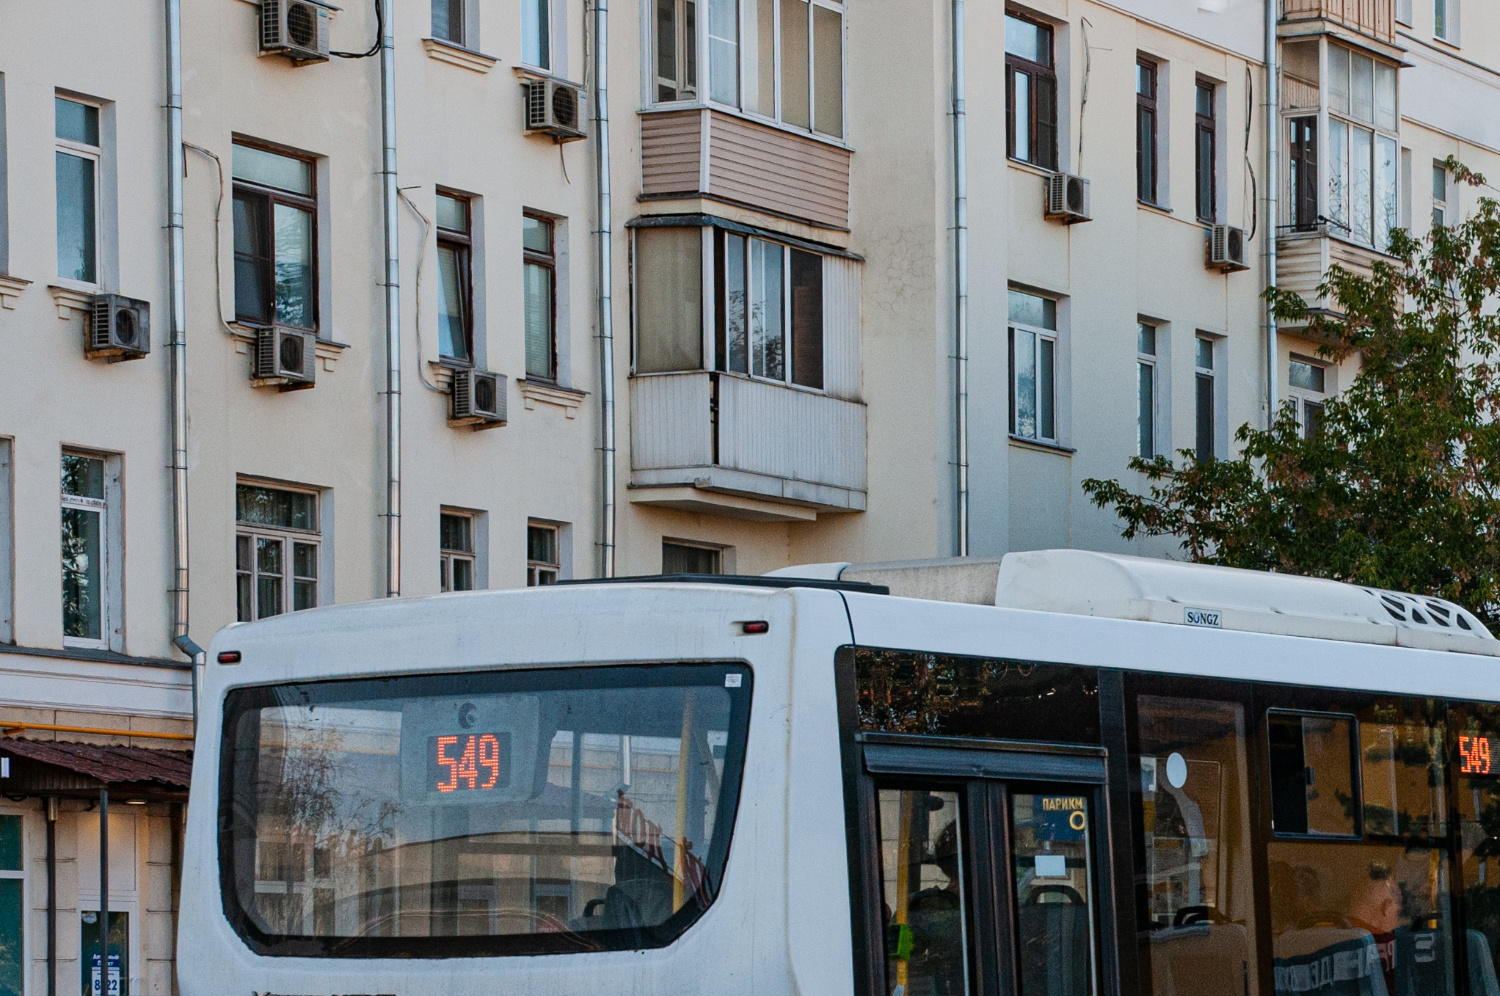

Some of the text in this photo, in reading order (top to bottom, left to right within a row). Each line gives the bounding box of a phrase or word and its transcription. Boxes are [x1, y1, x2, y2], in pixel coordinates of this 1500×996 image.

[1187, 611, 1219, 626] SONGZ
[437, 734, 499, 793] 549
[1459, 736, 1491, 775] 549
